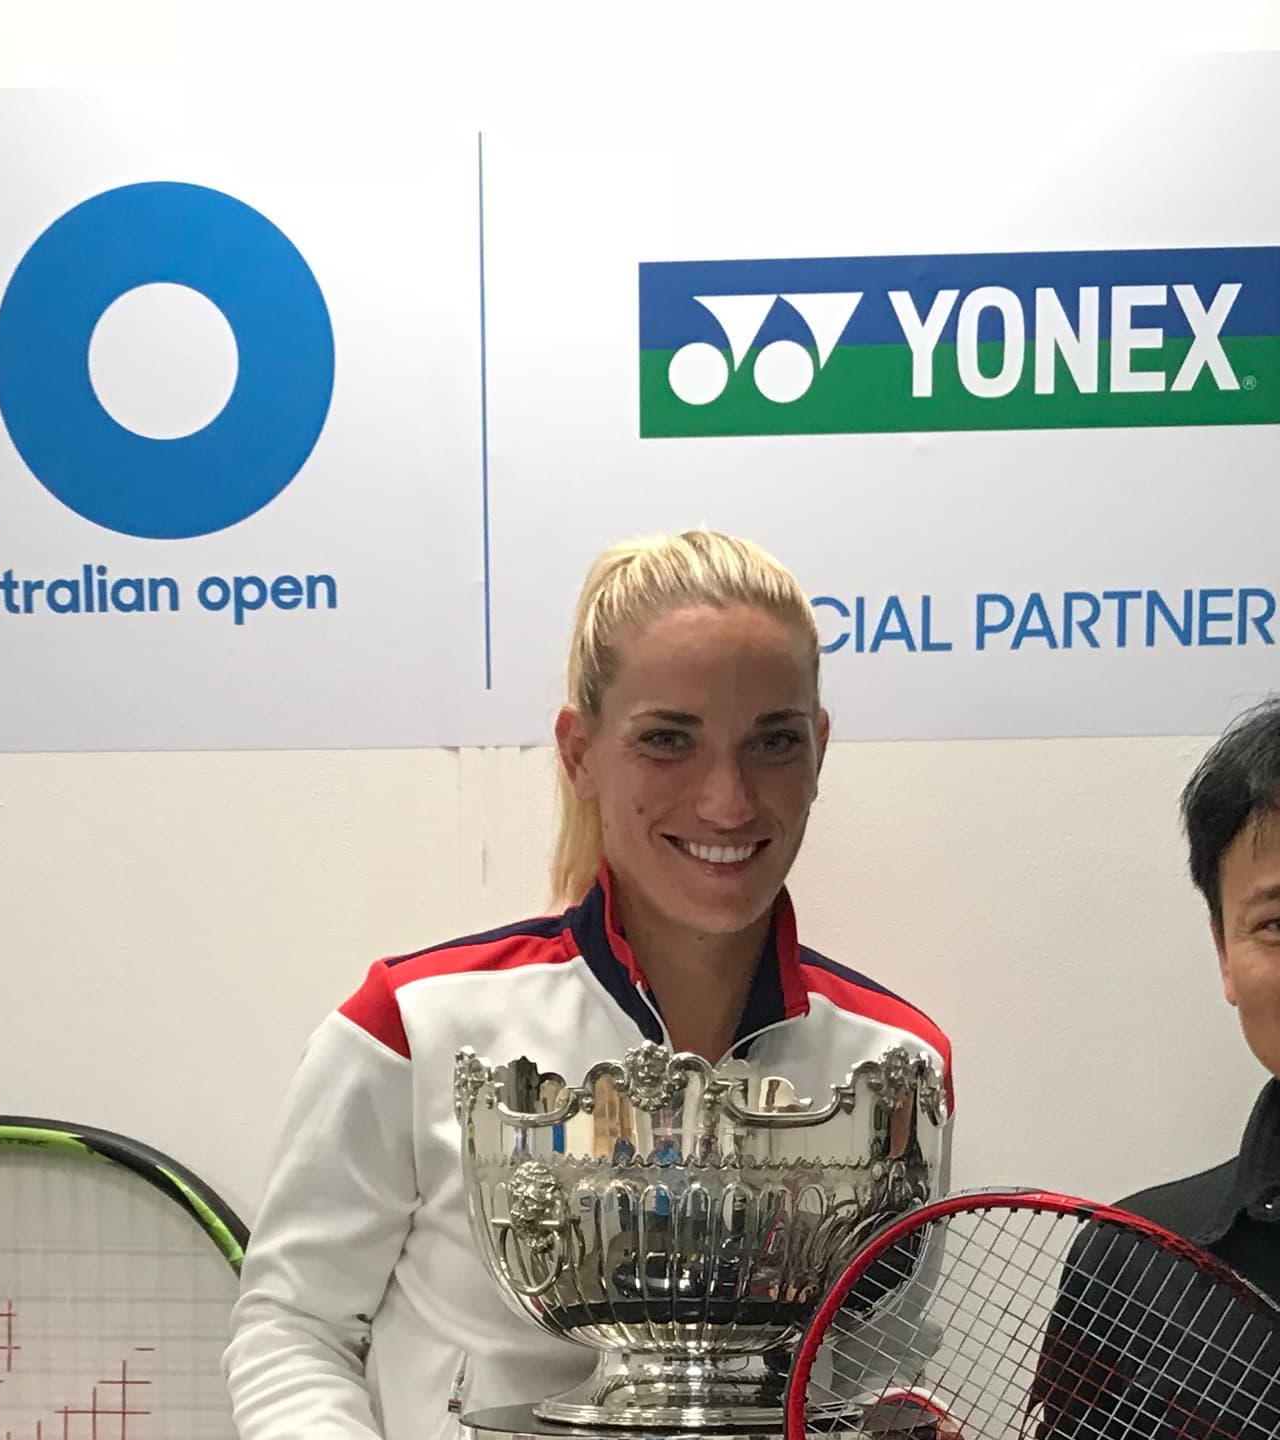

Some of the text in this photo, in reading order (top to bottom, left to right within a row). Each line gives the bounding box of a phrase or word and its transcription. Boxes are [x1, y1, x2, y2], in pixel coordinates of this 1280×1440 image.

[887, 283, 1243, 398] YONEX
[196, 570, 338, 625] open
[811, 588, 1277, 654] CIAL PARTNER
